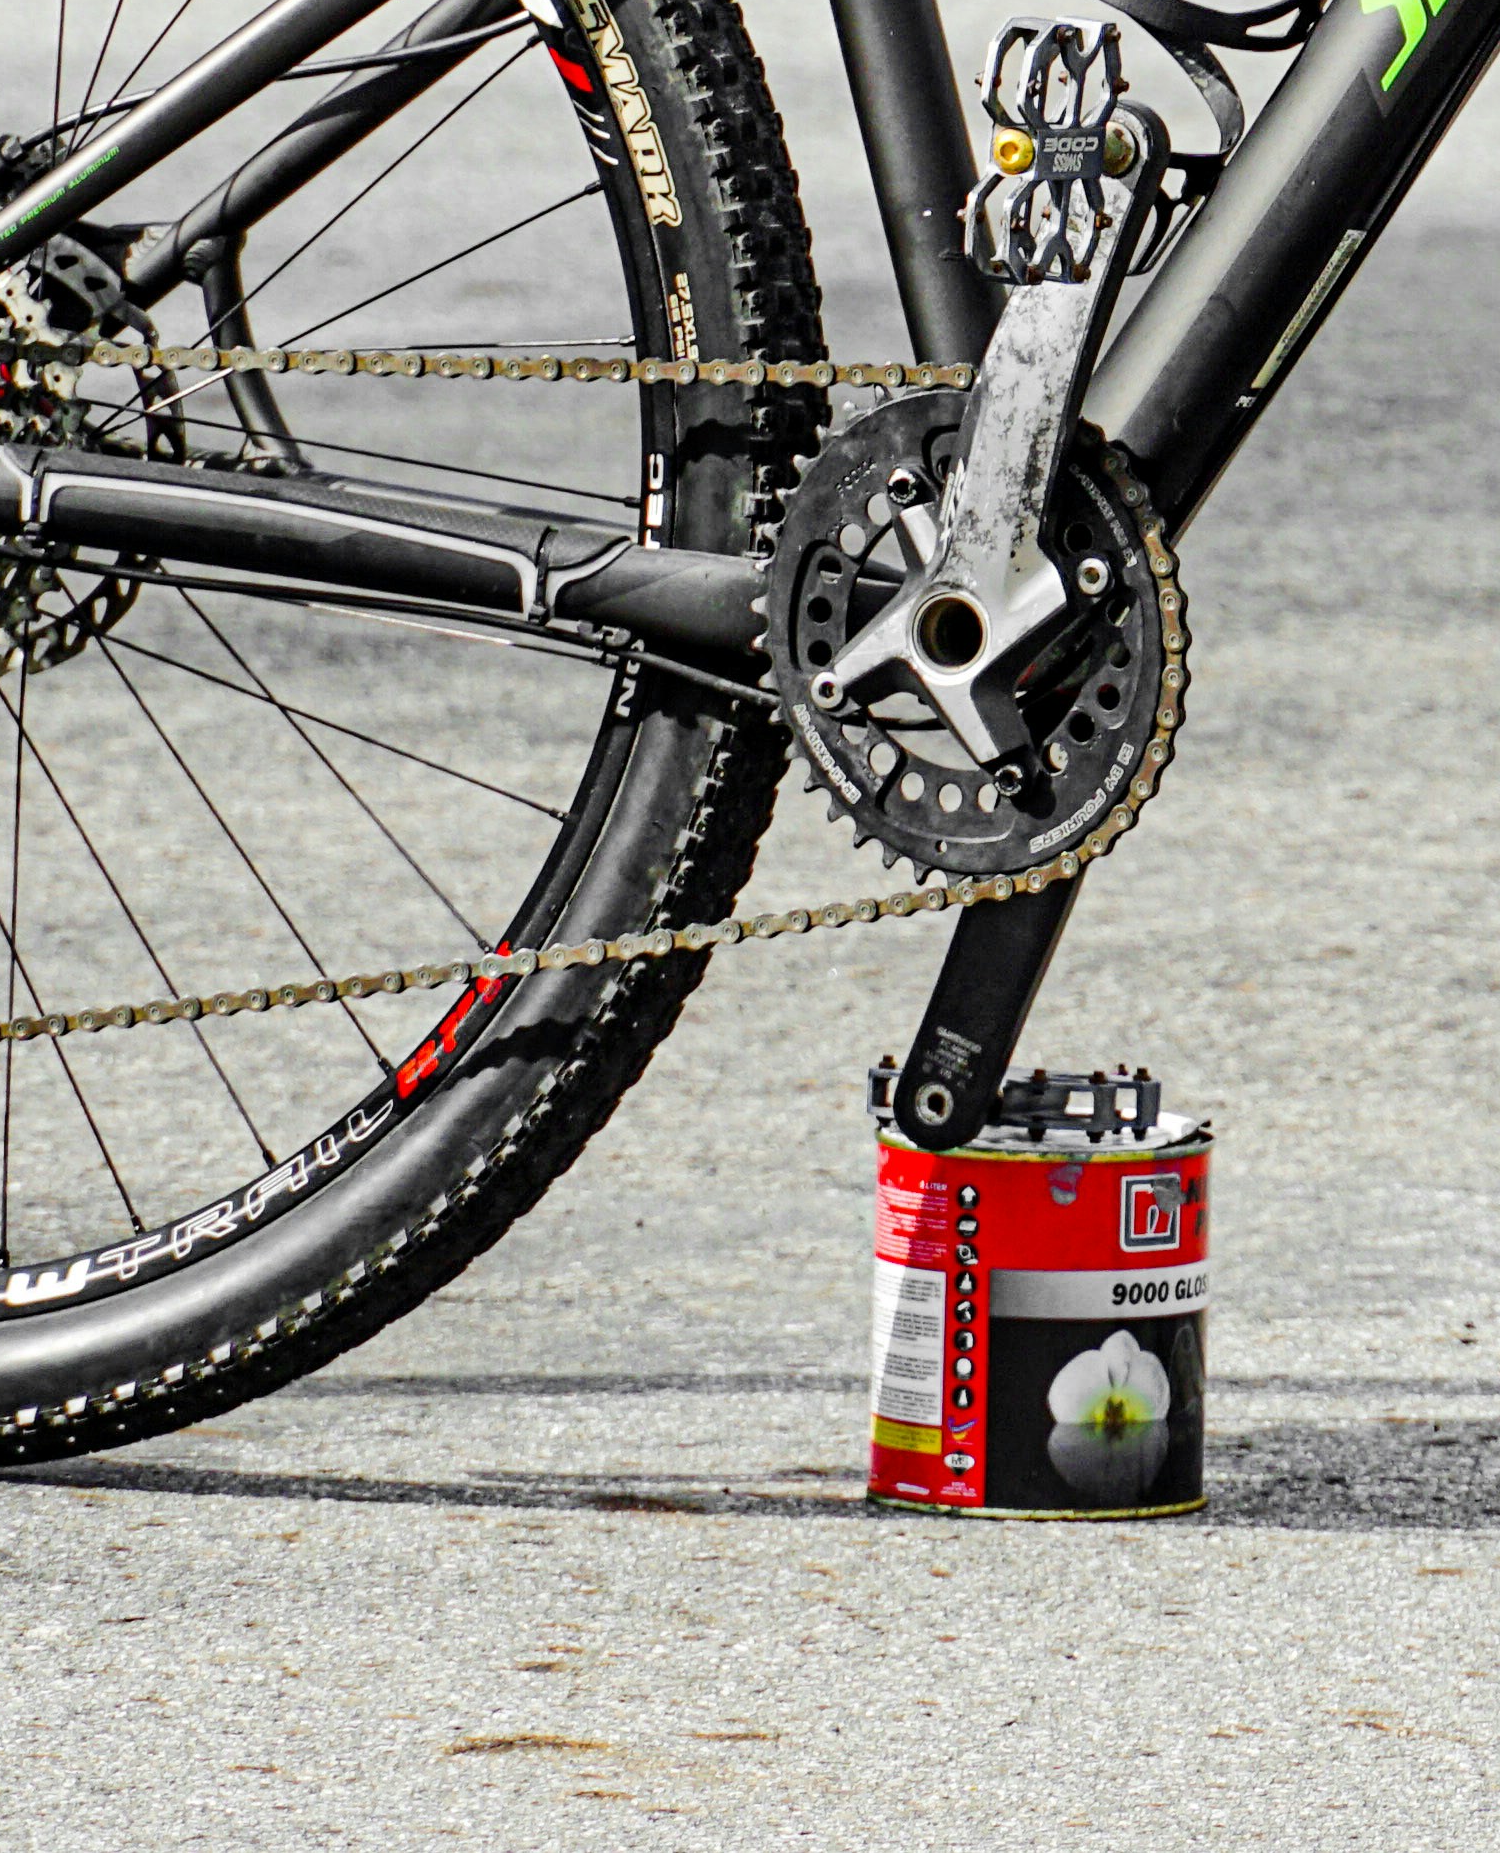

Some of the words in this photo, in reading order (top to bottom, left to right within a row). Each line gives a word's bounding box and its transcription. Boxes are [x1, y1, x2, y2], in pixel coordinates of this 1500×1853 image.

[1043, 136, 1099, 153] CODE
[19, 186, 67, 226] PREMIUM
[66, 146, 121, 191] ALUMINUM
[674, 272, 700, 364] 27.5X1.9
[613, 453, 665, 717] NOTEC
[1100, 763, 1126, 792] BY
[1028, 786, 1108, 855] FOURIERS
[1111, 1281, 1170, 1306] 9000
